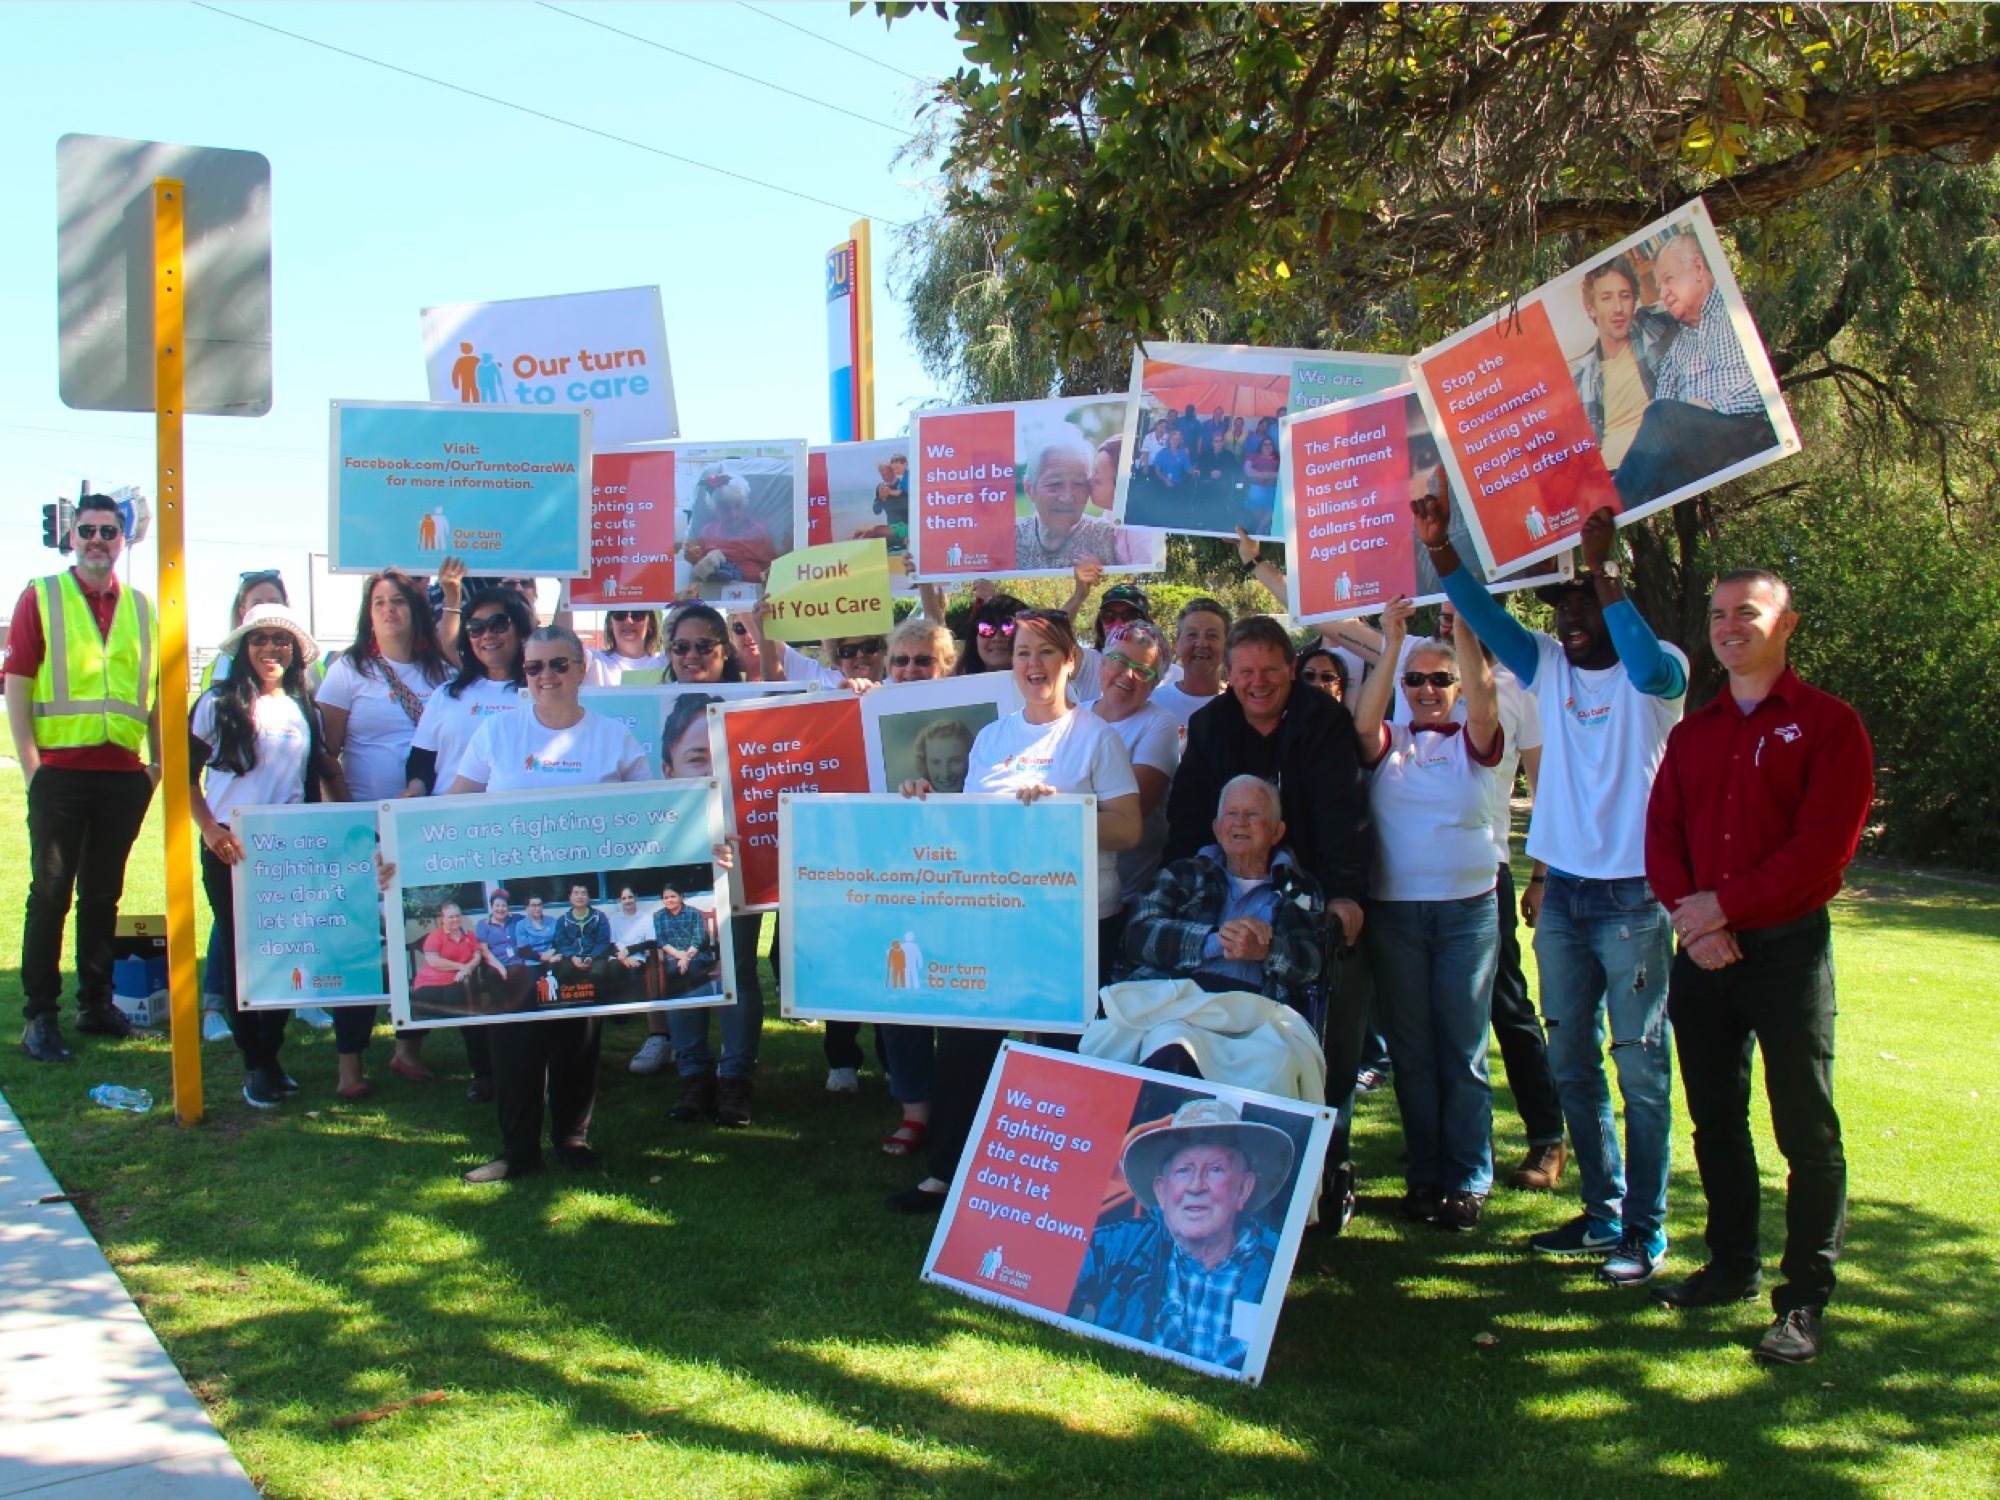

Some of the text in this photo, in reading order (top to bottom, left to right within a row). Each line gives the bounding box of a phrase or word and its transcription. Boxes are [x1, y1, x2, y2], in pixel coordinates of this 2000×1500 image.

[513, 349, 646, 379] Our turn
[1441, 354, 1504, 393] Stop the
[1298, 369, 1363, 387] We are
[515, 374, 650, 405] to care
[1449, 378, 1503, 414] Federal
[1458, 382, 1548, 434] Government
[1304, 425, 1387, 456] The Federal
[1464, 408, 1548, 455] hurting the
[443, 443, 480, 455] Visit:
[927, 444, 954, 458] We
[1473, 430, 1556, 479] people who
[1306, 446, 1393, 477] Government
[1480, 437, 1596, 497] looked after us.
[386, 475, 534, 490] for more information.
[926, 464, 1014, 483] should be
[592, 485, 627, 495] e are
[1306, 476, 1359, 497] has cut
[926, 488, 1007, 506] there for
[1307, 491, 1378, 518] billions of
[591, 500, 654, 515] ghting so
[605, 518, 636, 529] cuts
[926, 514, 978, 529] them.
[1309, 512, 1394, 539] dollars from
[454, 529, 502, 539] Our turn
[617, 535, 636, 546] let
[454, 539, 502, 550] to care
[1310, 536, 1388, 561] Aged Care.
[632, 552, 672, 563] down.
[797, 559, 849, 581] Honk
[771, 596, 882, 620] If You Care
[738, 740, 801, 757] We are
[740, 758, 840, 781] fighting so
[743, 786, 774, 802] the
[421, 808, 679, 842] We are fighting so we
[746, 810, 779, 824] don
[252, 834, 328, 850] We are
[749, 833, 779, 849] any
[425, 838, 667, 872] don't let them down.
[912, 846, 958, 861] Visit:
[254, 857, 371, 881] fighting so
[798, 866, 1078, 887] Facebook.com/OurTurntoCareWA
[256, 884, 346, 903] we don't
[846, 889, 1027, 908] for more information.
[257, 912, 348, 929] let them
[259, 939, 320, 955] down.
[928, 962, 987, 975] Our turn
[928, 975, 986, 989] to care
[1006, 1088, 1066, 1118] We are
[996, 1114, 1092, 1153] fighting so
[986, 1140, 1060, 1174] the cuts
[977, 1166, 1051, 1201] don't let
[968, 1195, 1088, 1242] anyone down.
